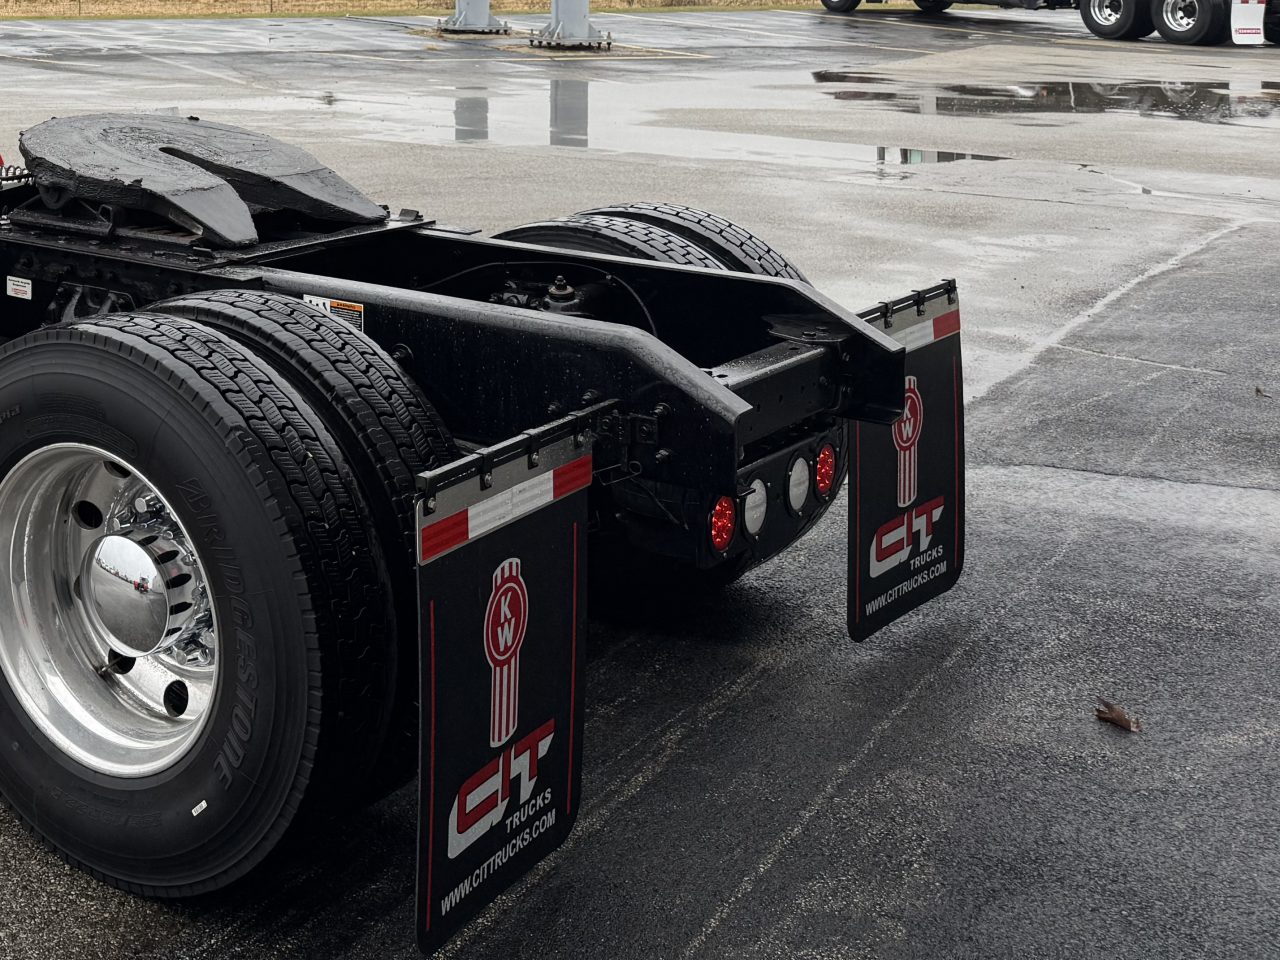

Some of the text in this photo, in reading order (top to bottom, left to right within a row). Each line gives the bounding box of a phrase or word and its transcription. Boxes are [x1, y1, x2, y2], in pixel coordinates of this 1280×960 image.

[870, 495, 945, 578] CIT
[910, 545, 943, 571] TRUCKS
[865, 560, 947, 616] WWW.CITTRUCKS.COM
[176, 477, 259, 790] BRIDGESTONE
[448, 719, 556, 857] CIT
[505, 787, 552, 834] TRUCKS
[441, 808, 556, 916] WWW.CITTRUCKS.COM
